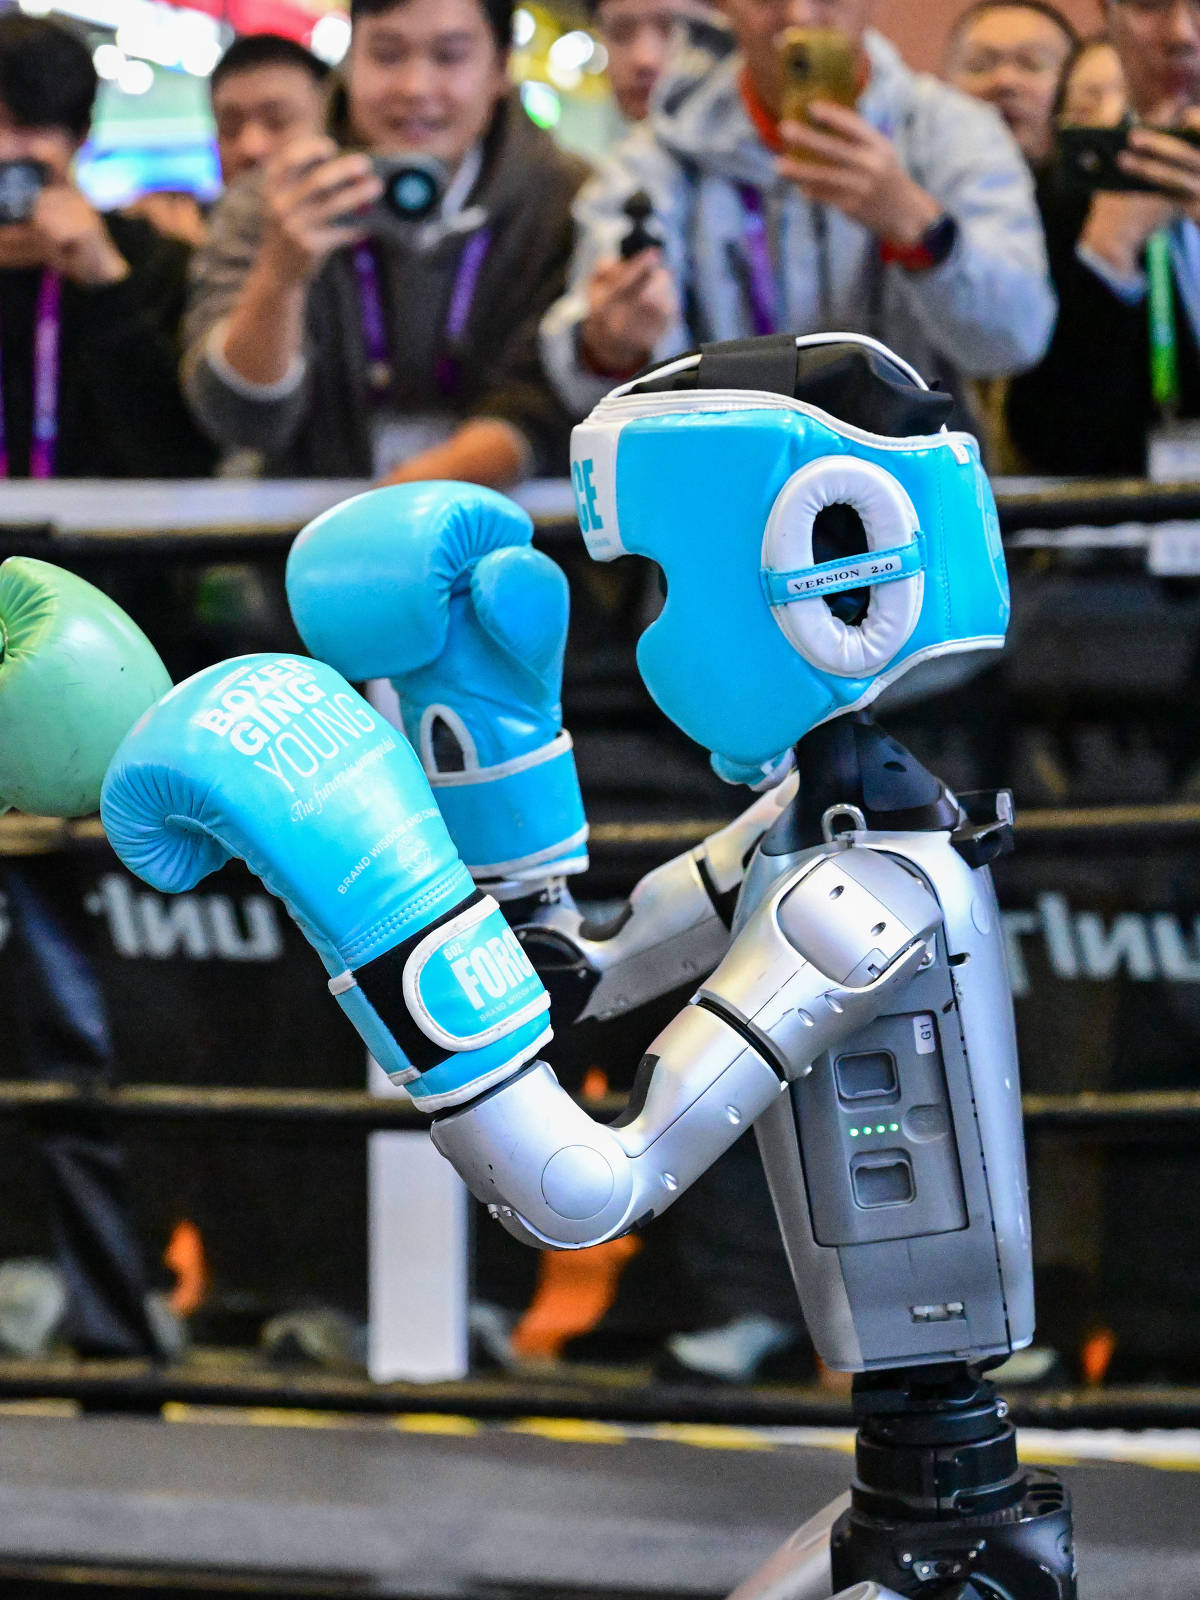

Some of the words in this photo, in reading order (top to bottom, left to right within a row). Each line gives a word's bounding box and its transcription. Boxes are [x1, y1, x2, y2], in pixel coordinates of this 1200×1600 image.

[571, 458, 604, 533] CE
[793, 568, 860, 591] VERSION
[870, 562, 894, 574] 2.0
[199, 658, 313, 737] BOXER
[229, 676, 326, 756] GING
[253, 692, 376, 793] YOUNG
[337, 856, 371, 895] BRAND
[450, 928, 535, 1011] FORC
[919, 1023, 931, 1040] G1
